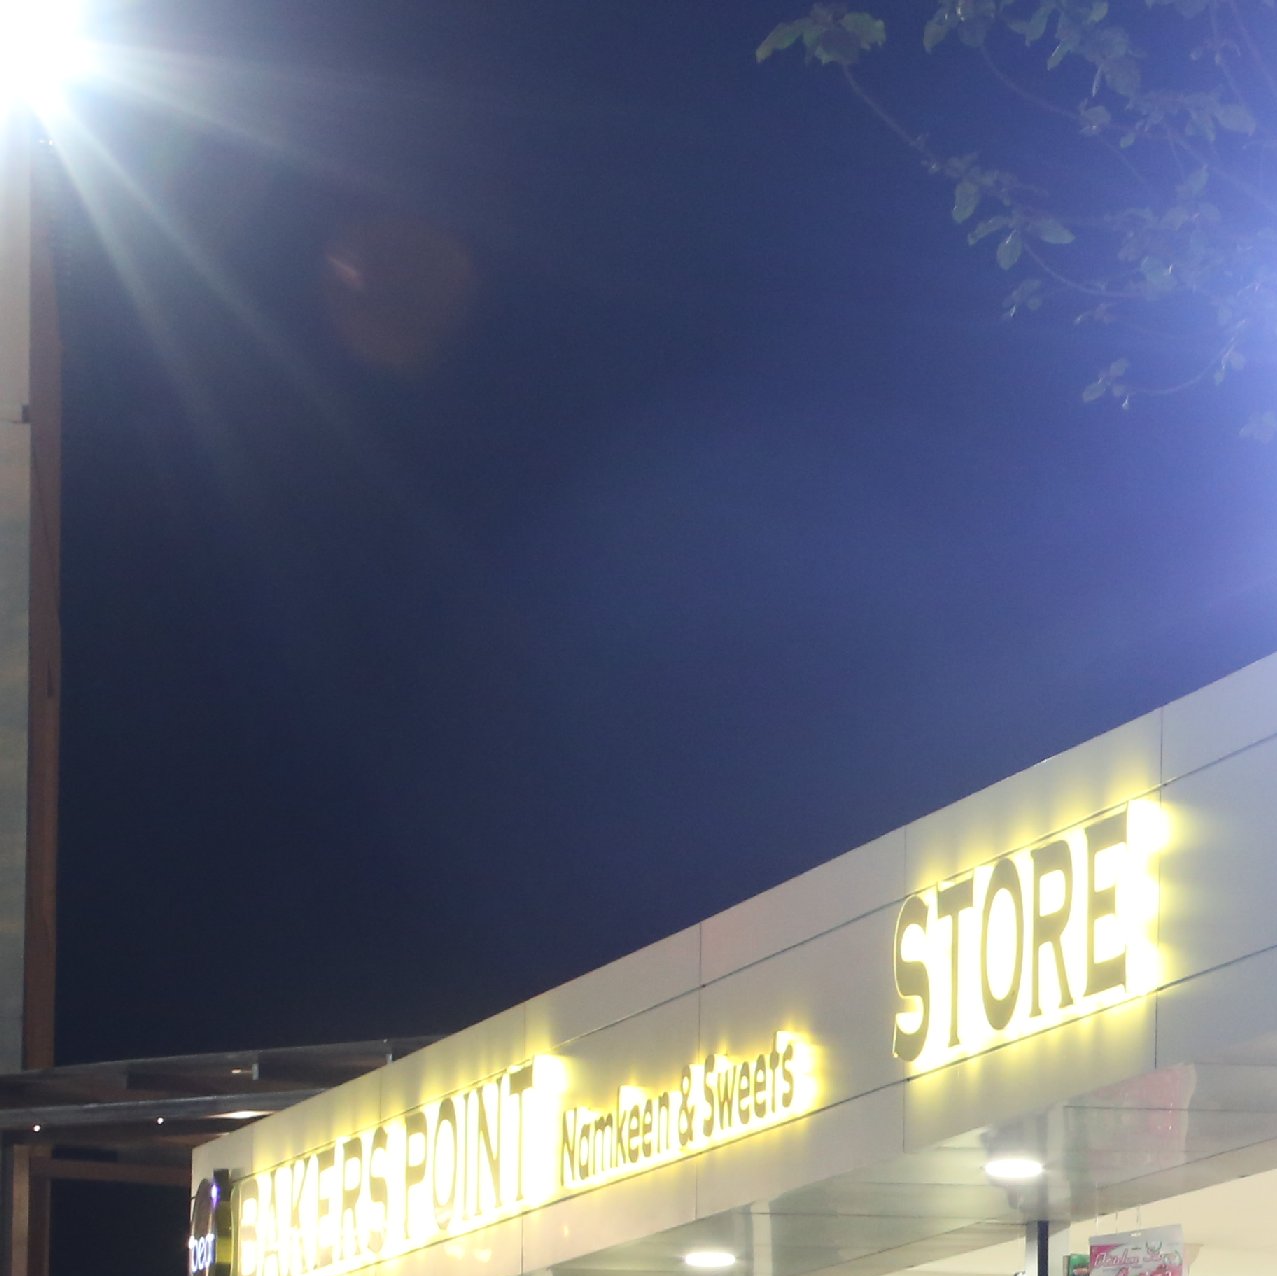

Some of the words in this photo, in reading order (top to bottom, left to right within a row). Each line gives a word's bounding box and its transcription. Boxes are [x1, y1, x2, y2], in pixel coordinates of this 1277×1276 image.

[892, 805, 1128, 1063] STORE
[403, 1062, 535, 1242] POINT
[560, 1084, 671, 1187] Namkeen
[678, 1064, 696, 1147] &
[702, 1032, 795, 1137] Sweets
